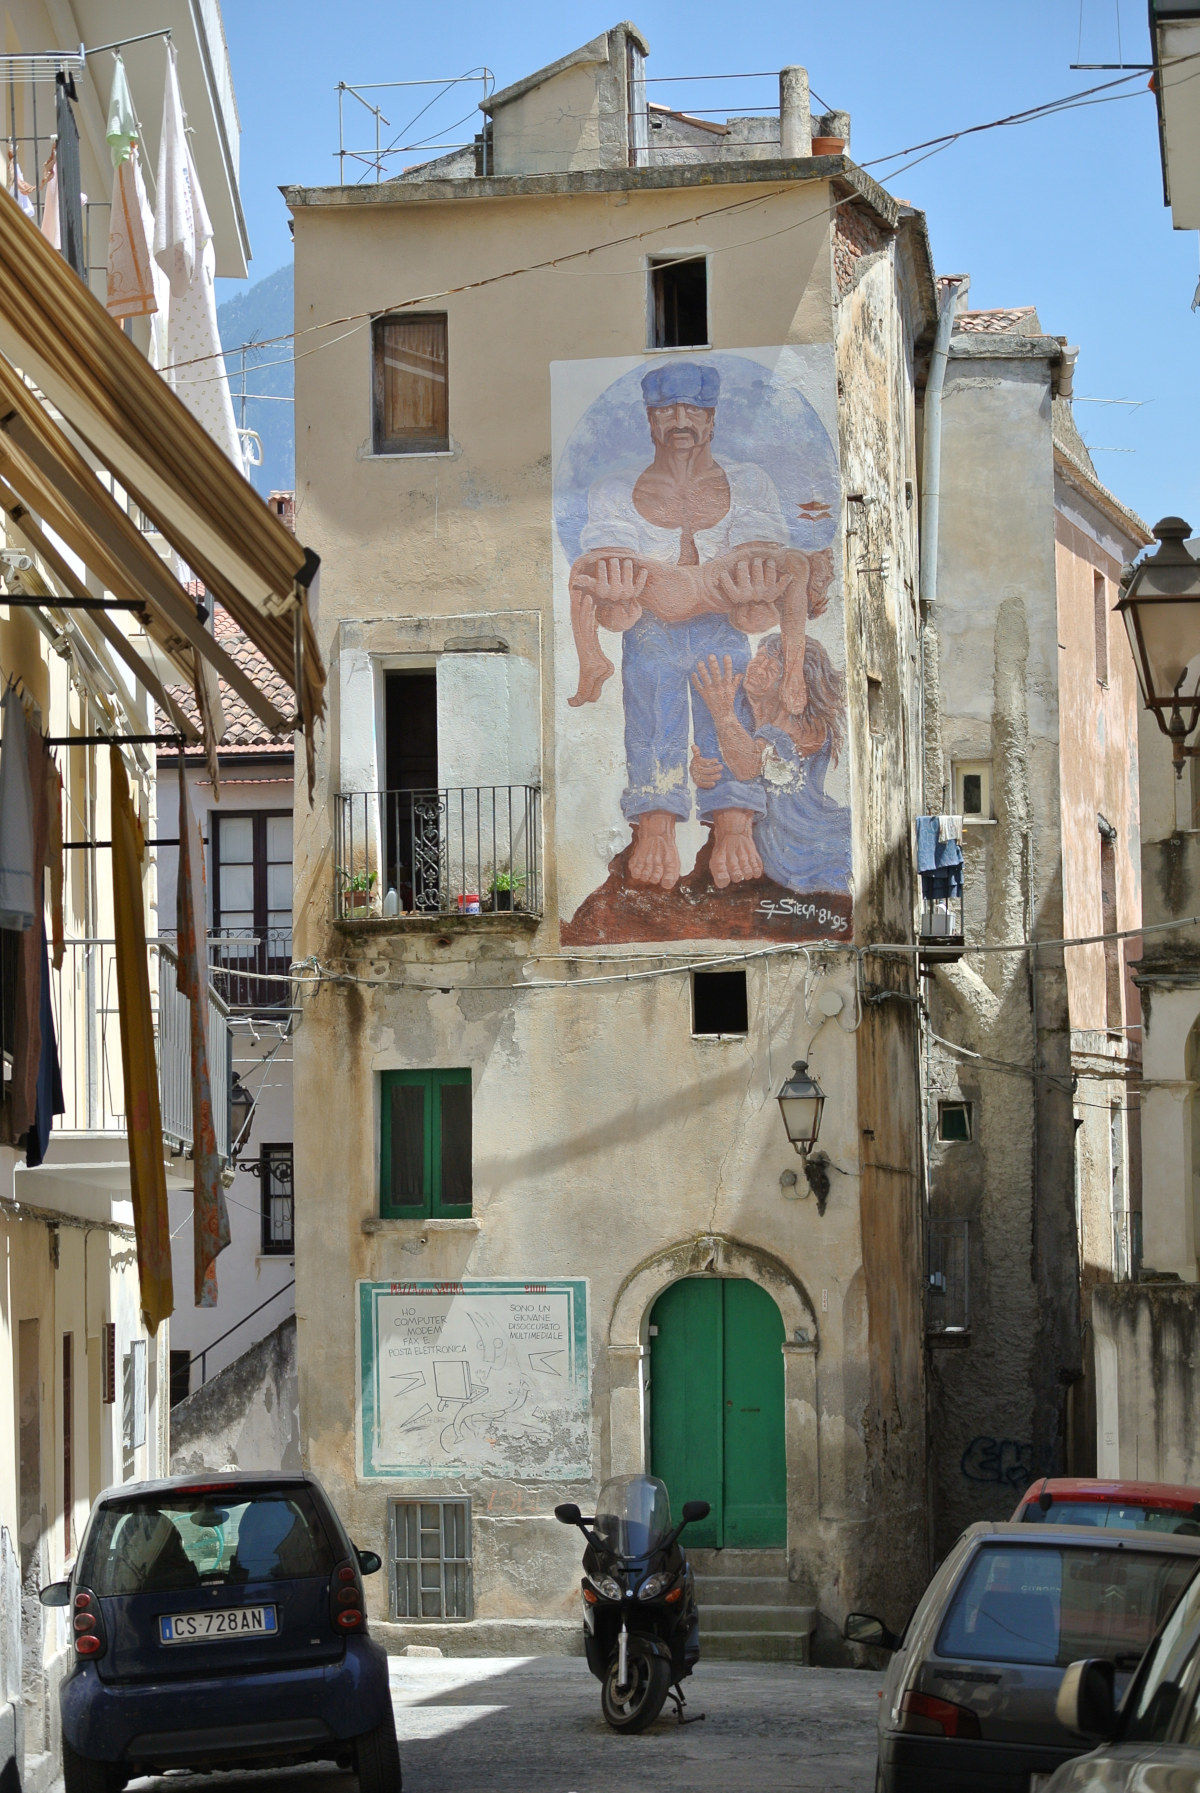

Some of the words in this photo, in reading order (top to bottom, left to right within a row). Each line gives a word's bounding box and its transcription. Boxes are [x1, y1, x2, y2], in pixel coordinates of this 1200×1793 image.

[401, 1307, 416, 1316] HO
[509, 1304, 535, 1312] SONO
[538, 1304, 551, 1312] UN
[393, 1315, 448, 1327] COMPUTER
[513, 1313, 551, 1322] GIOVANE
[407, 1326, 443, 1336] MODEM
[508, 1322, 561, 1331] DISOCCUPATO
[509, 1331, 563, 1340] MULTIMEDIALE
[402, 1337, 420, 1346] FAX
[388, 1347, 413, 1358] POSTA
[414, 1344, 467, 1356] ELETTRONICA
